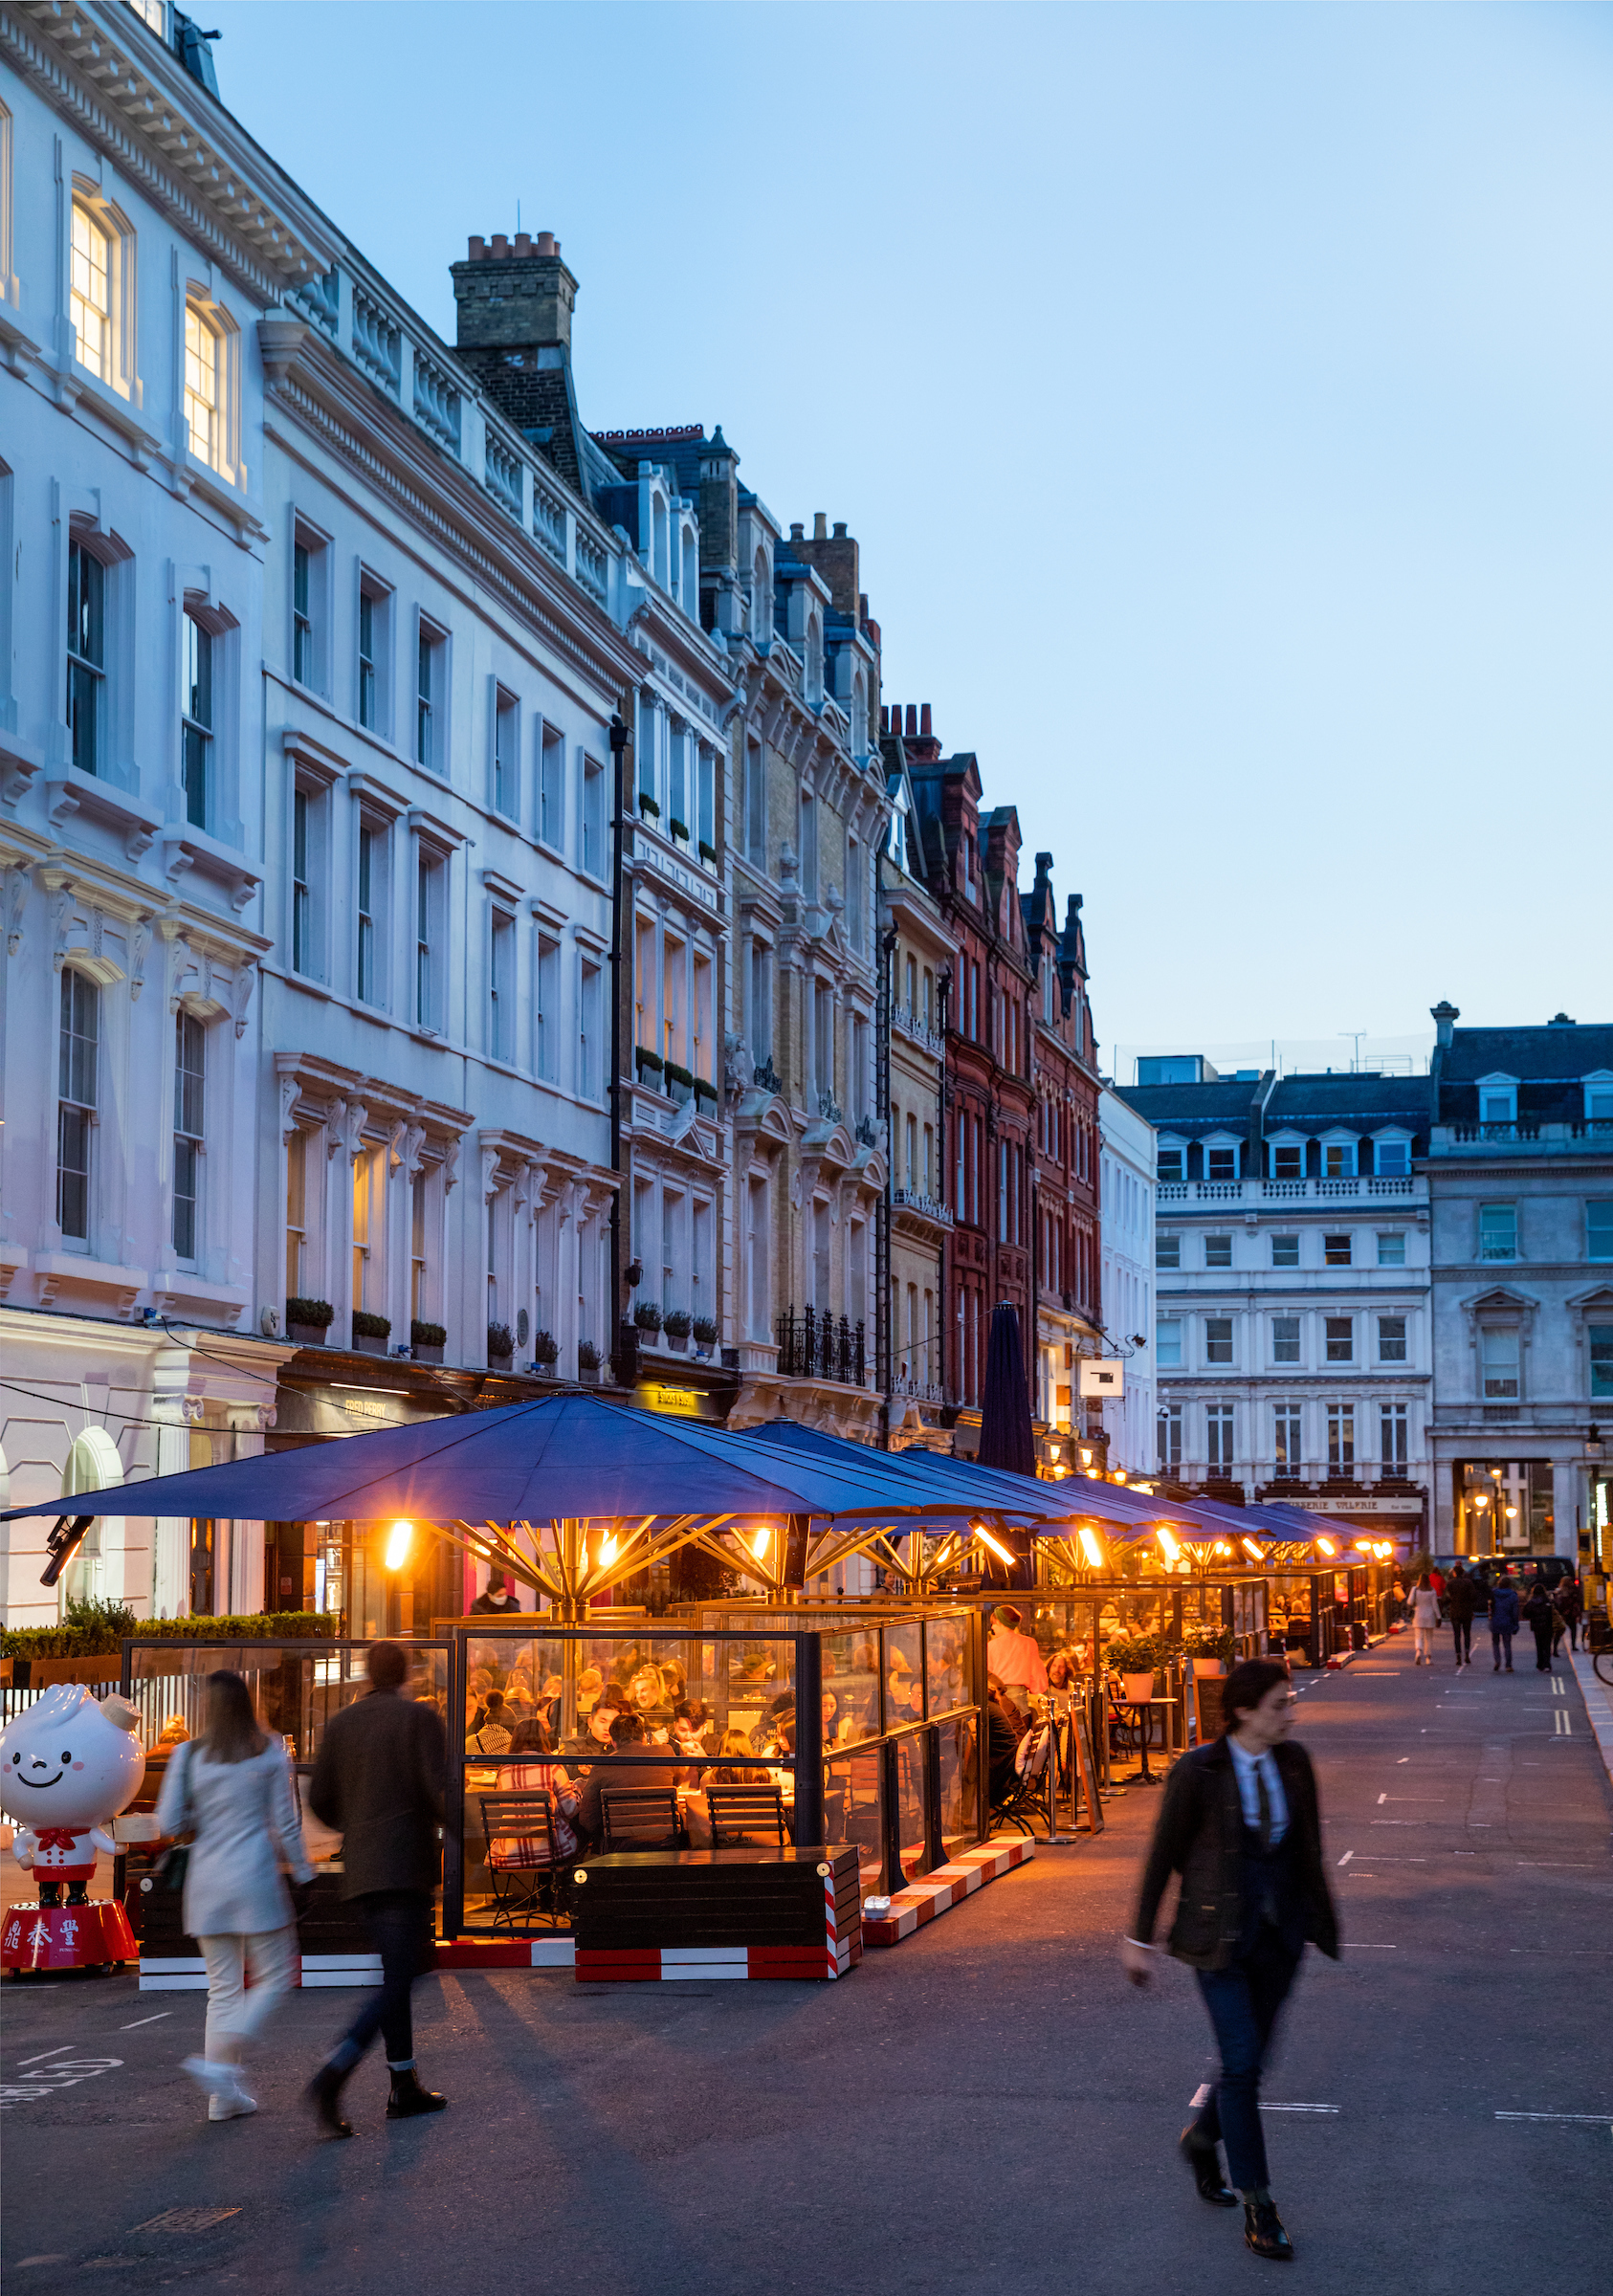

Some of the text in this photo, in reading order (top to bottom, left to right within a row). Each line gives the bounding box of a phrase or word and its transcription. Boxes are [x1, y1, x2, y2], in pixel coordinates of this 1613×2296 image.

[345, 1399, 387, 1418] FRED PERRY
[1335, 1501, 1378, 1510] VALERIE
[4, 1919, 79, 1950] 鼎泰豐
